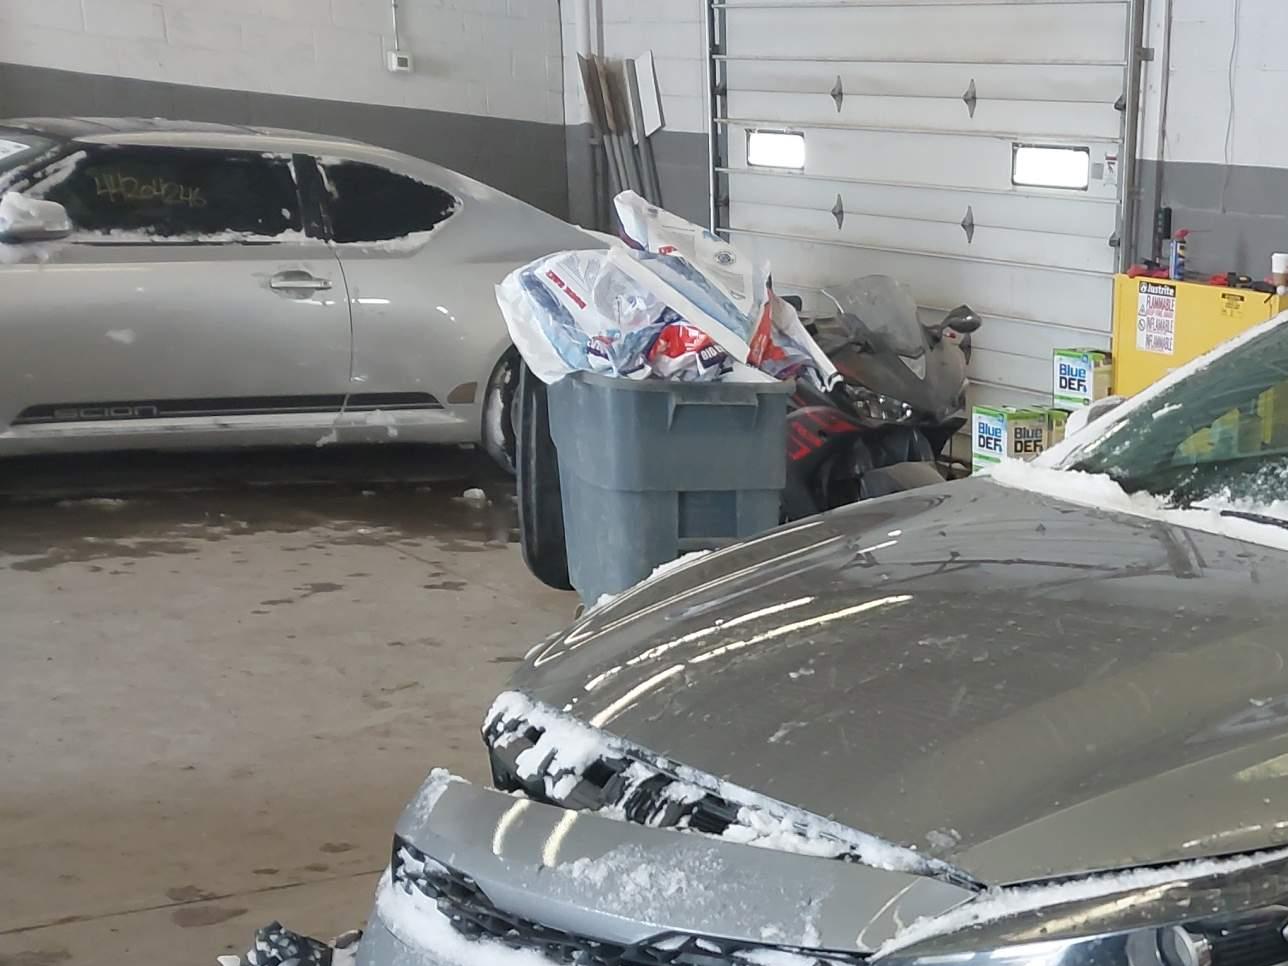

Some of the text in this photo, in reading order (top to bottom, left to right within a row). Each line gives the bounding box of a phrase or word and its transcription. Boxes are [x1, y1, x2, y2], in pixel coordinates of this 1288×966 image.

[1059, 363, 1086, 378] Blue
[1059, 377, 1088, 392] DEF
[978, 422, 1002, 438] Blue
[1014, 427, 1043, 439] Blue
[978, 435, 1003, 452] DEF
